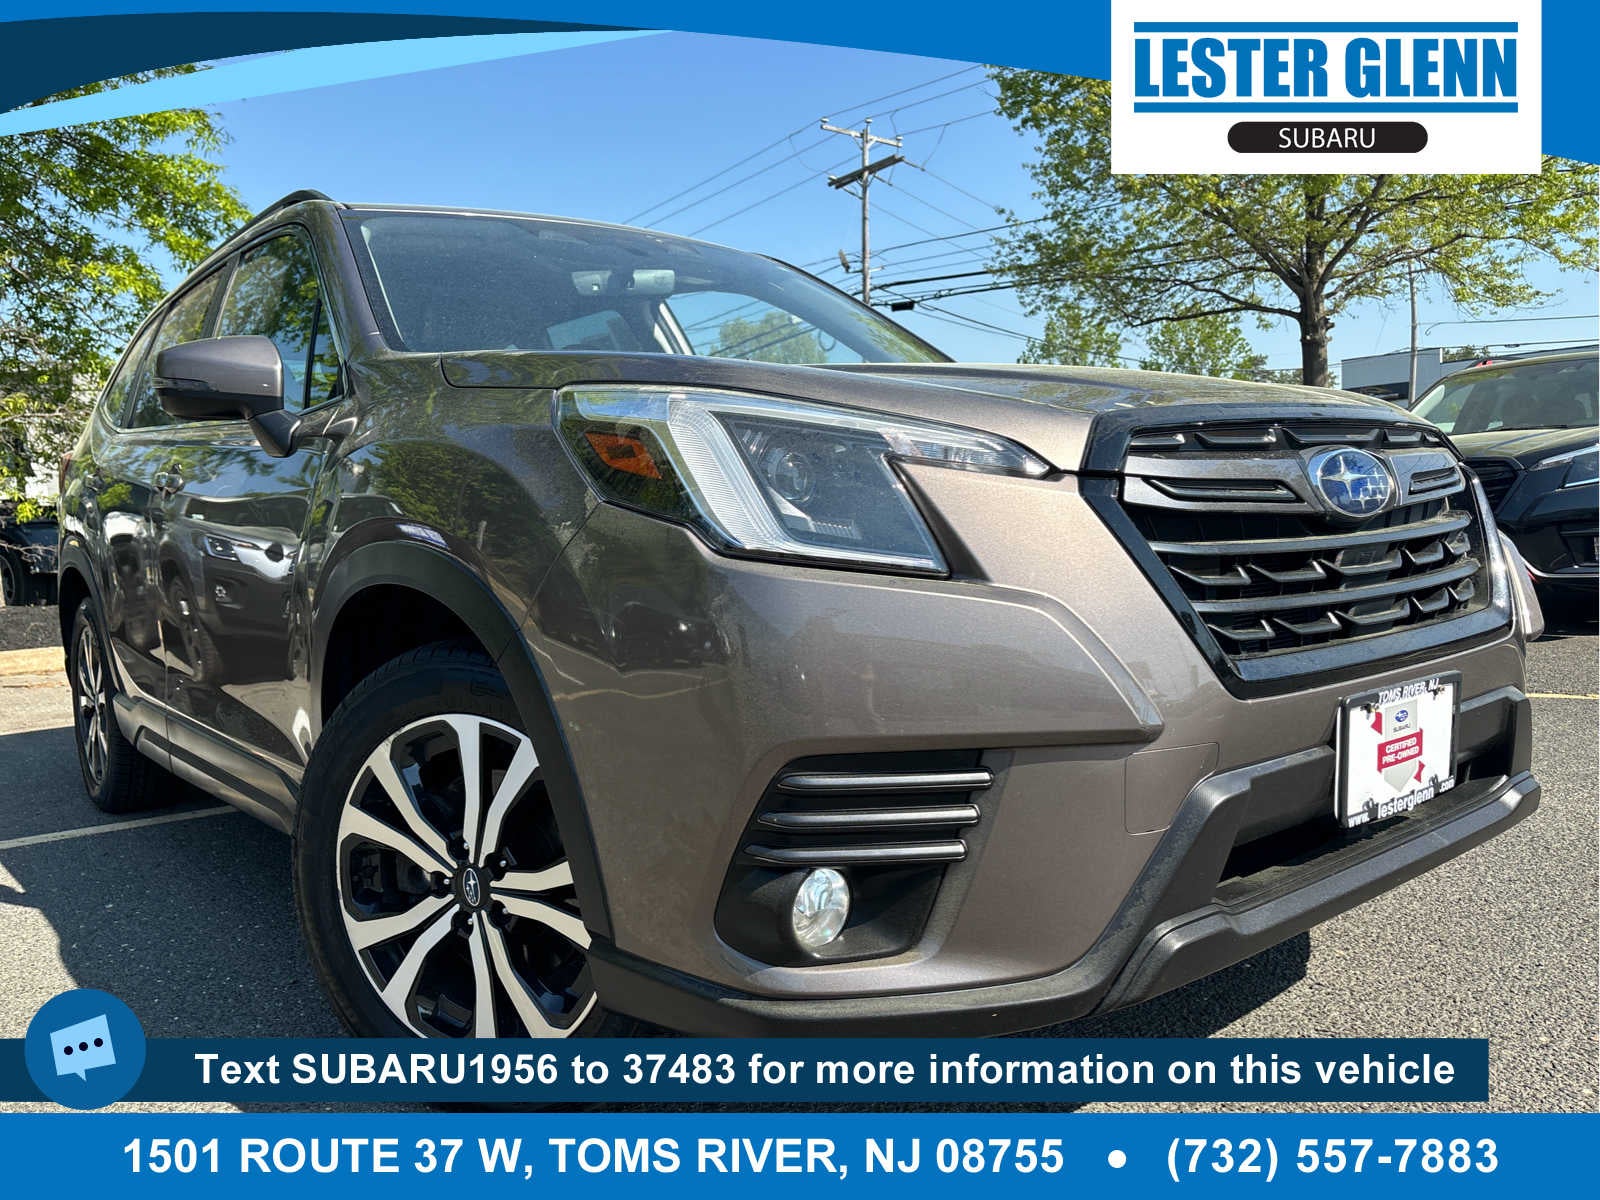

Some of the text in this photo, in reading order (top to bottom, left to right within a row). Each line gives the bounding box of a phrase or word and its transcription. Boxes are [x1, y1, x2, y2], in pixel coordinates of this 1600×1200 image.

[1379, 687, 1402, 704] TOMS
[1428, 678, 1440, 691] NJ
[1386, 737, 1417, 754] CERTIFIED
[1382, 746, 1419, 765] PRE-OWNED
